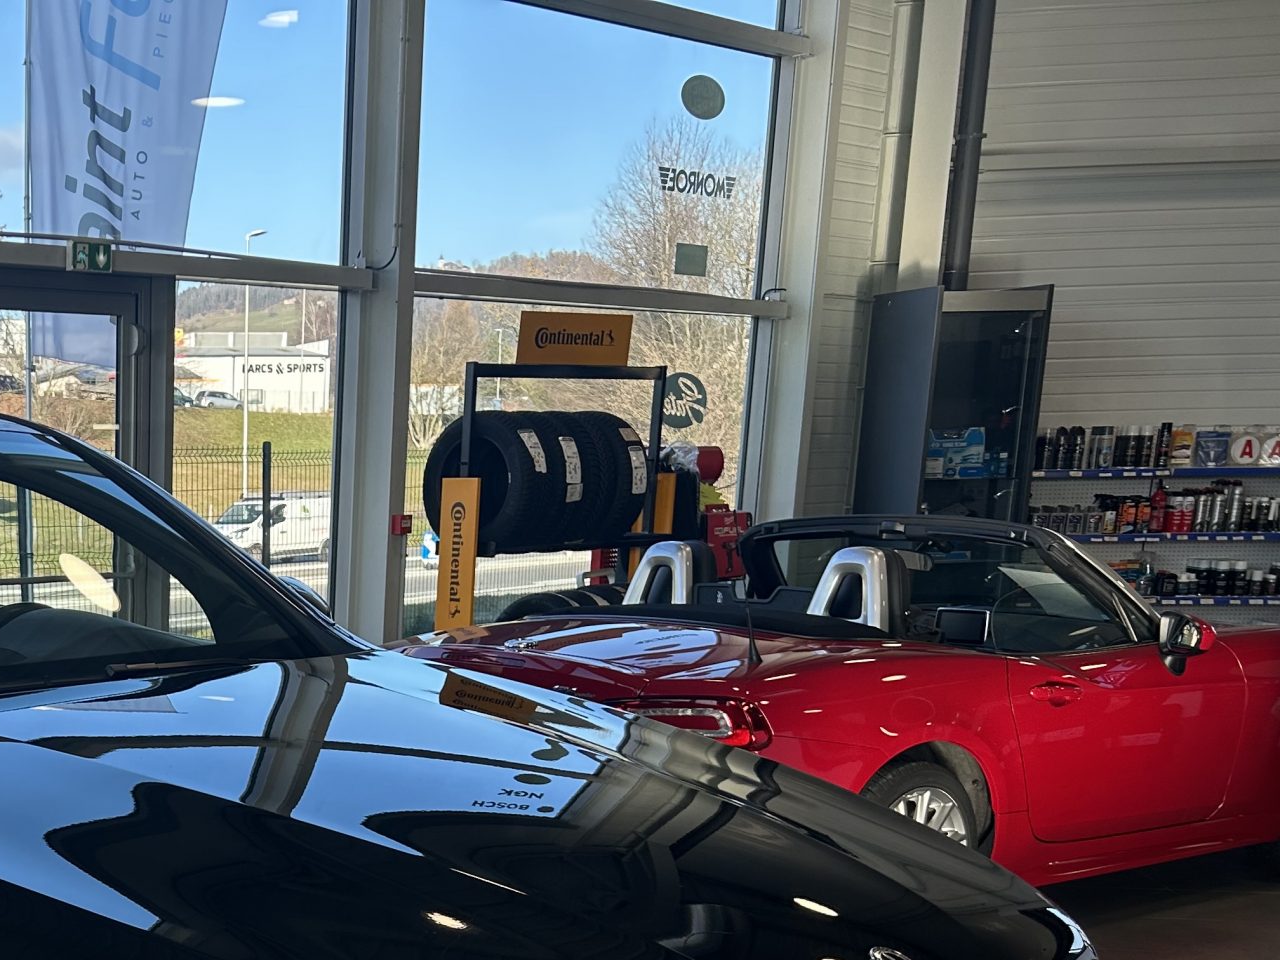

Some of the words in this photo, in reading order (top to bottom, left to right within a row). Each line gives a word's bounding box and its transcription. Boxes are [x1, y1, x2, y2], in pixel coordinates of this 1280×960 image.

[64, 84, 132, 246] aint
[130, 150, 149, 221] AUTO
[535, 327, 604, 349] Continental
[1239, 440, 1253, 458] A
[449, 501, 466, 602] Continental
